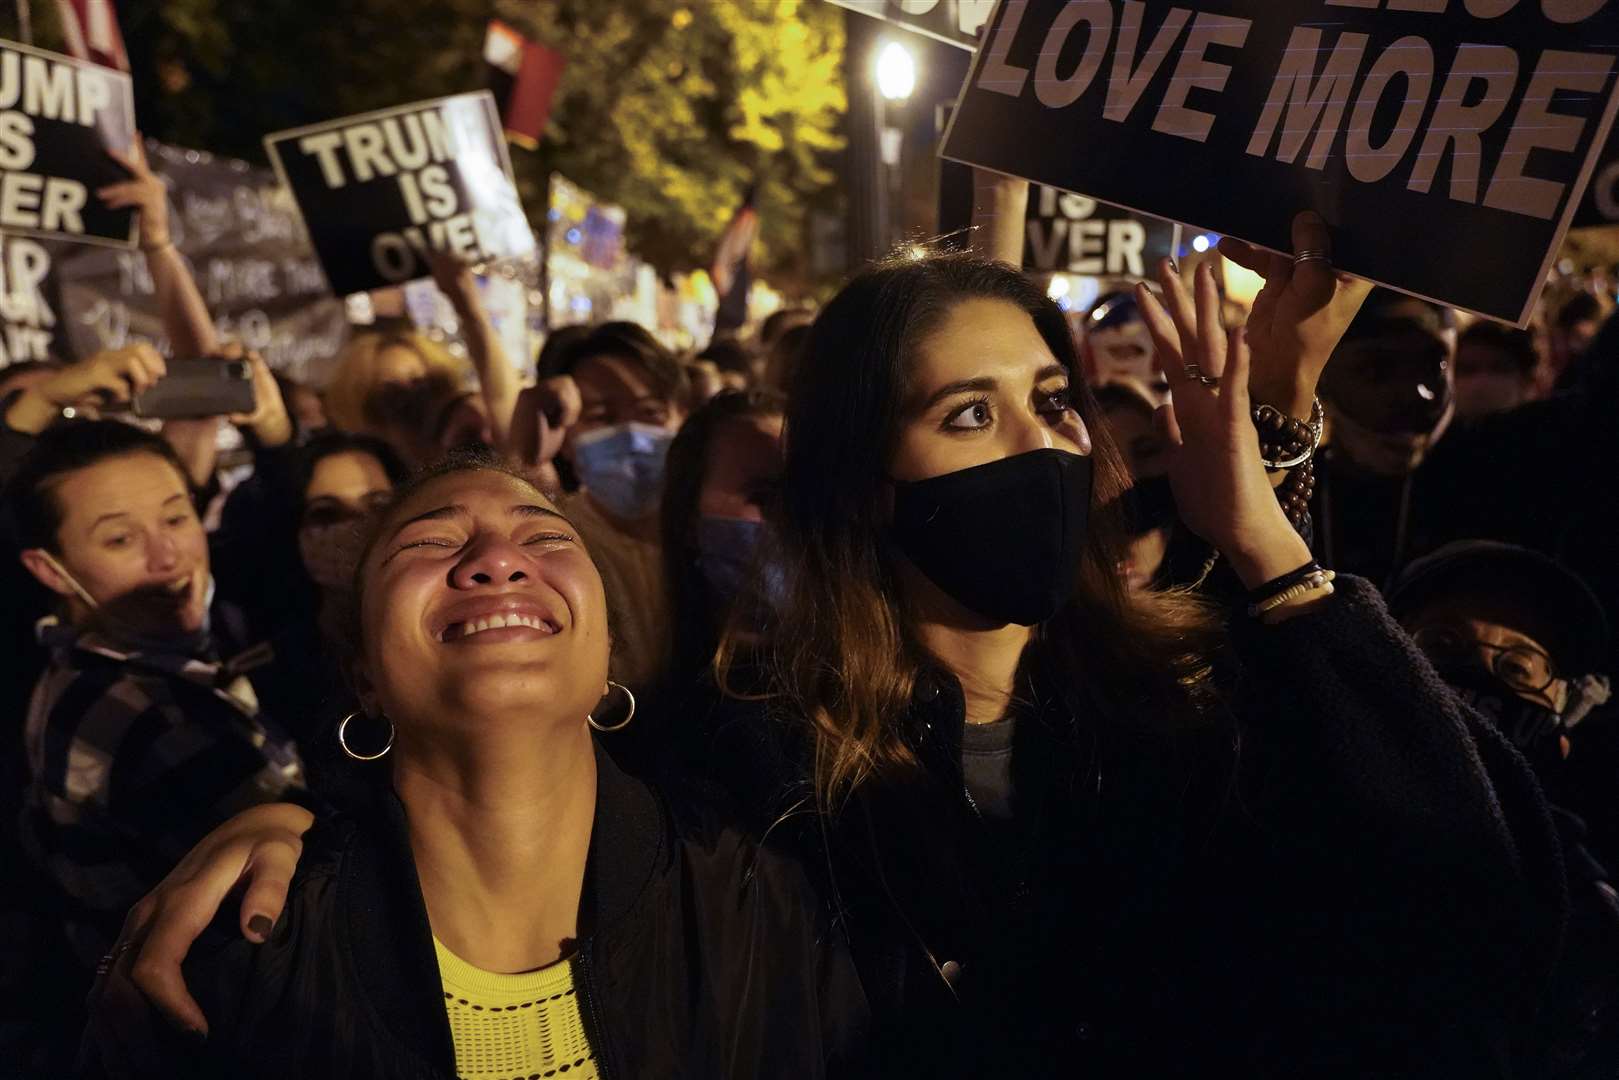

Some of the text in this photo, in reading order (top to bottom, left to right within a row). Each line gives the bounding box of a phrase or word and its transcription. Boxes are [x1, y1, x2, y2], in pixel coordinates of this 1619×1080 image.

[300, 108, 470, 190] TRUM
[977, 0, 1616, 220] LOVE MORE
[400, 164, 459, 226] IS
